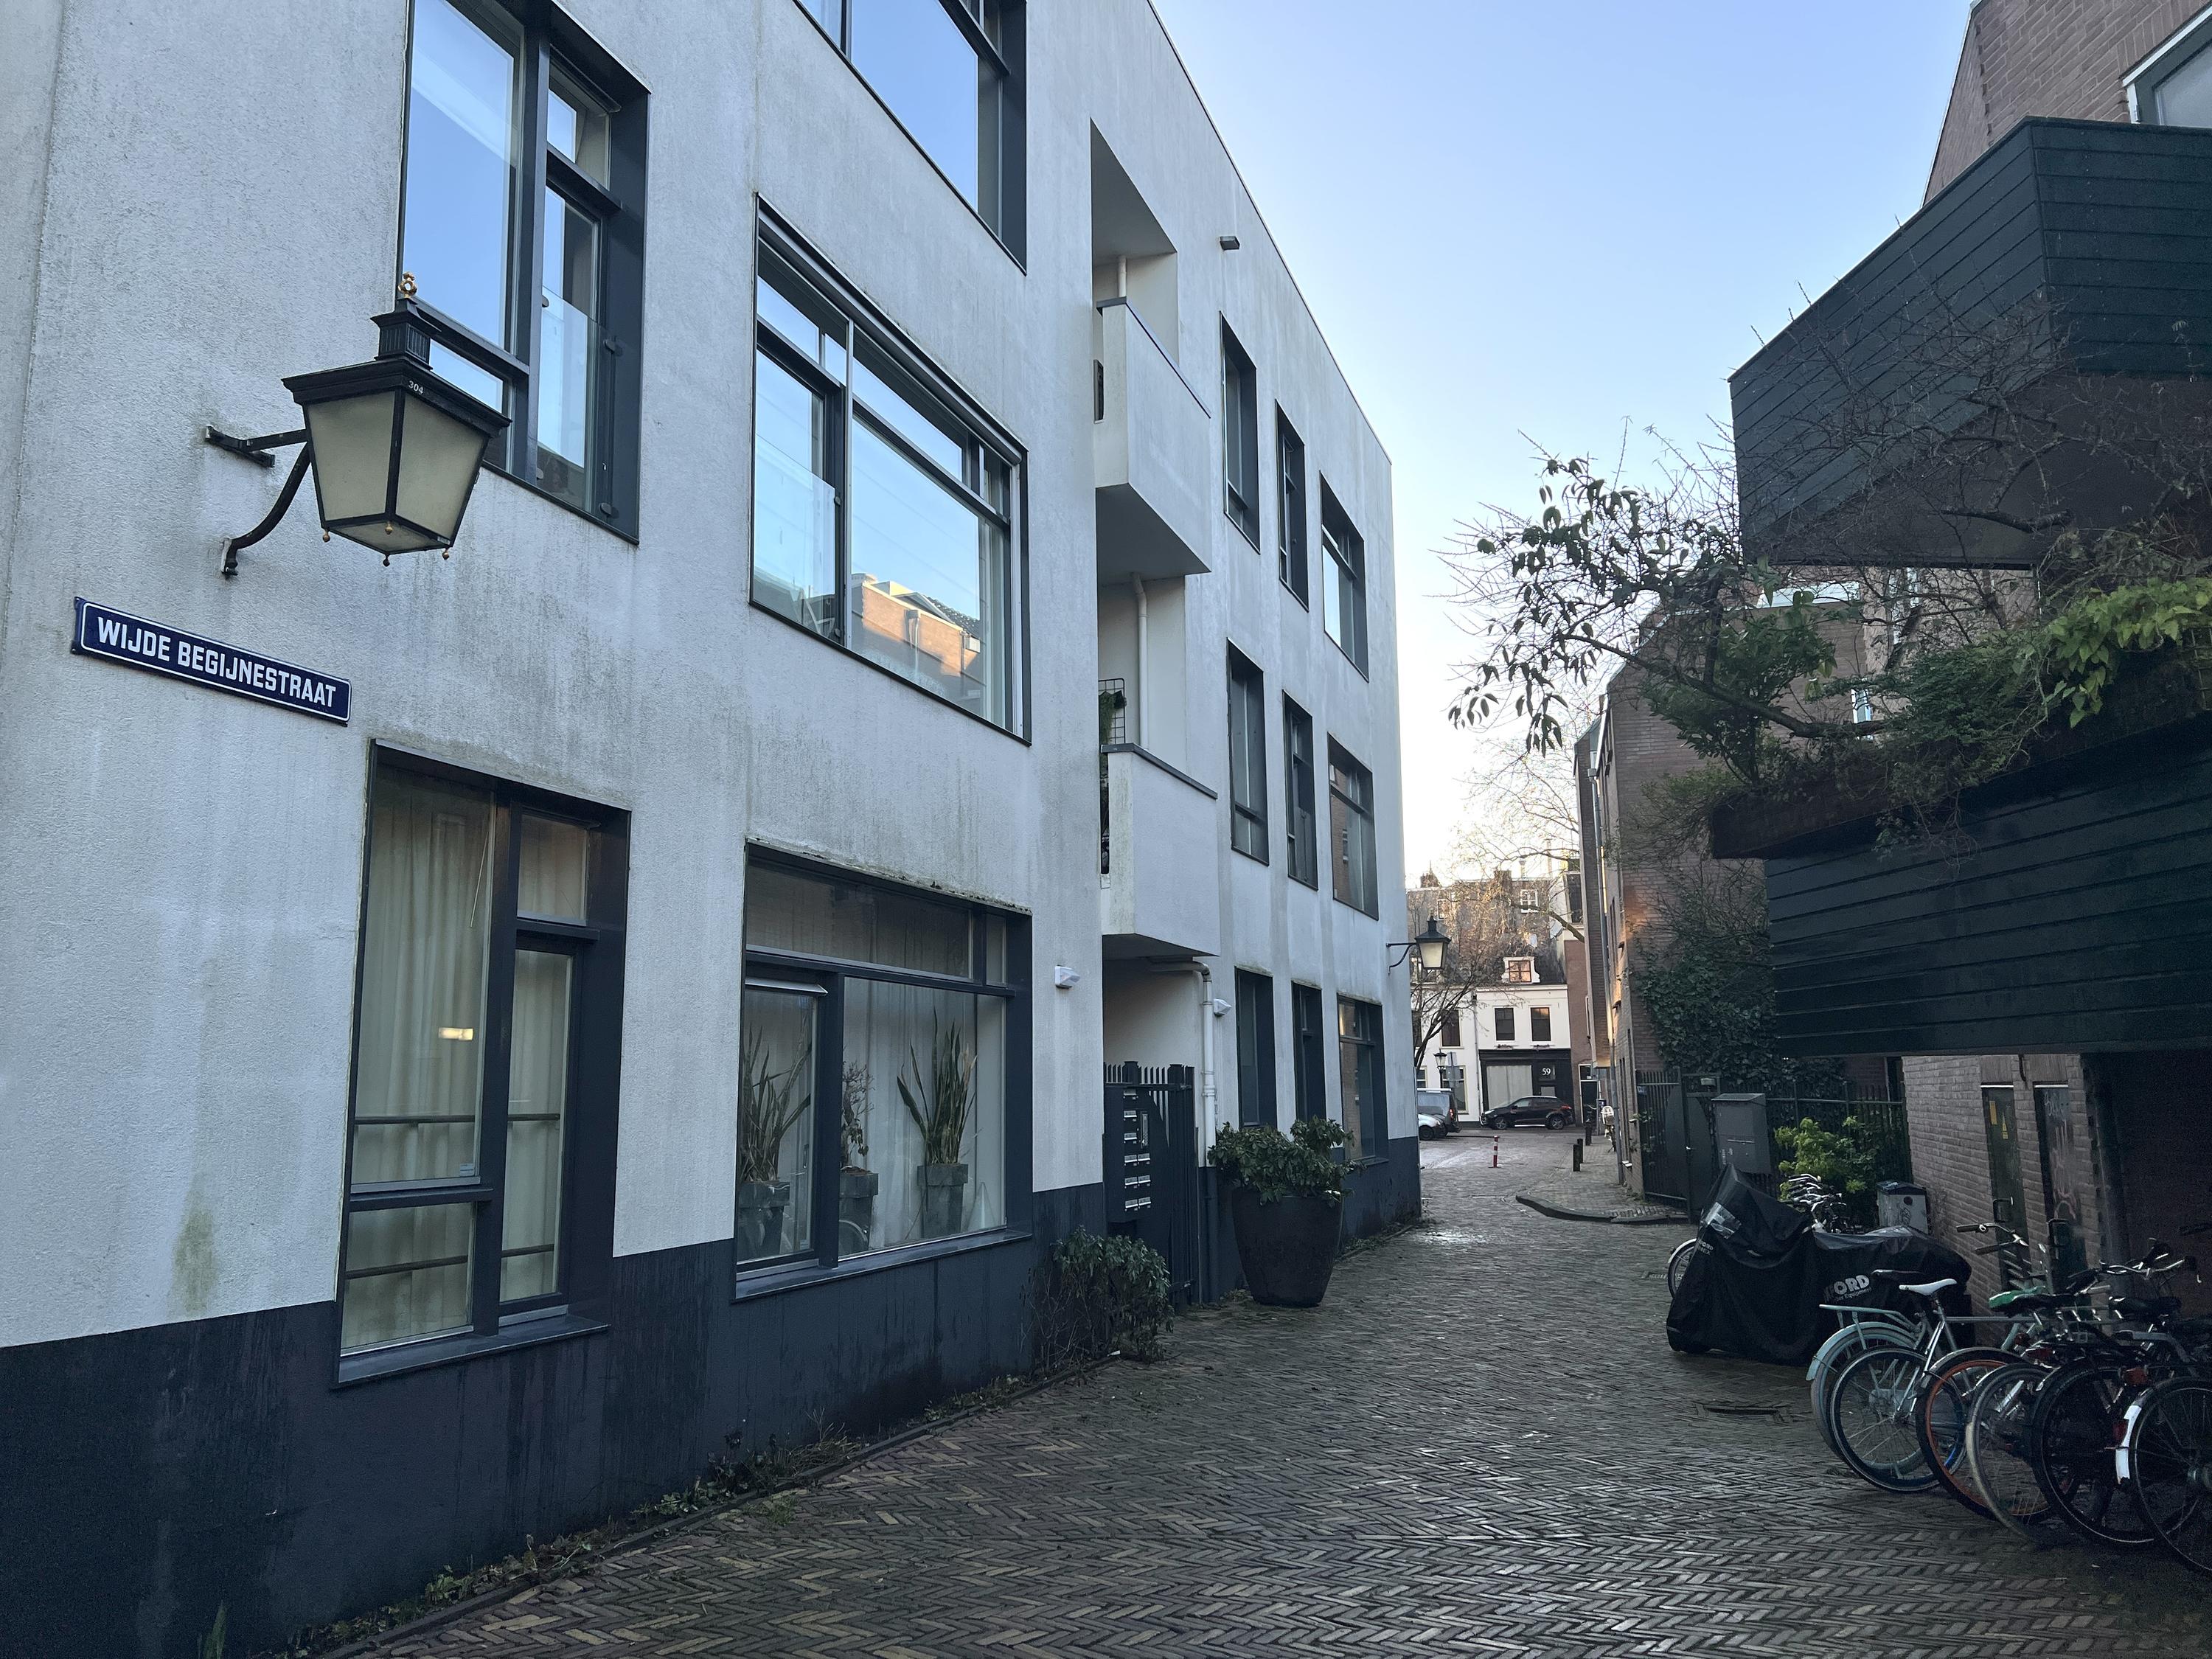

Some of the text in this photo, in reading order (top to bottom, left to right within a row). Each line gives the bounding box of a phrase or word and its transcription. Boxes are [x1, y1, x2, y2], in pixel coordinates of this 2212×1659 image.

[408, 380, 423, 394] 304
[97, 616, 336, 708] WIJDE BEGIJNESTRAAT
[1542, 1068, 1551, 1076] 59
